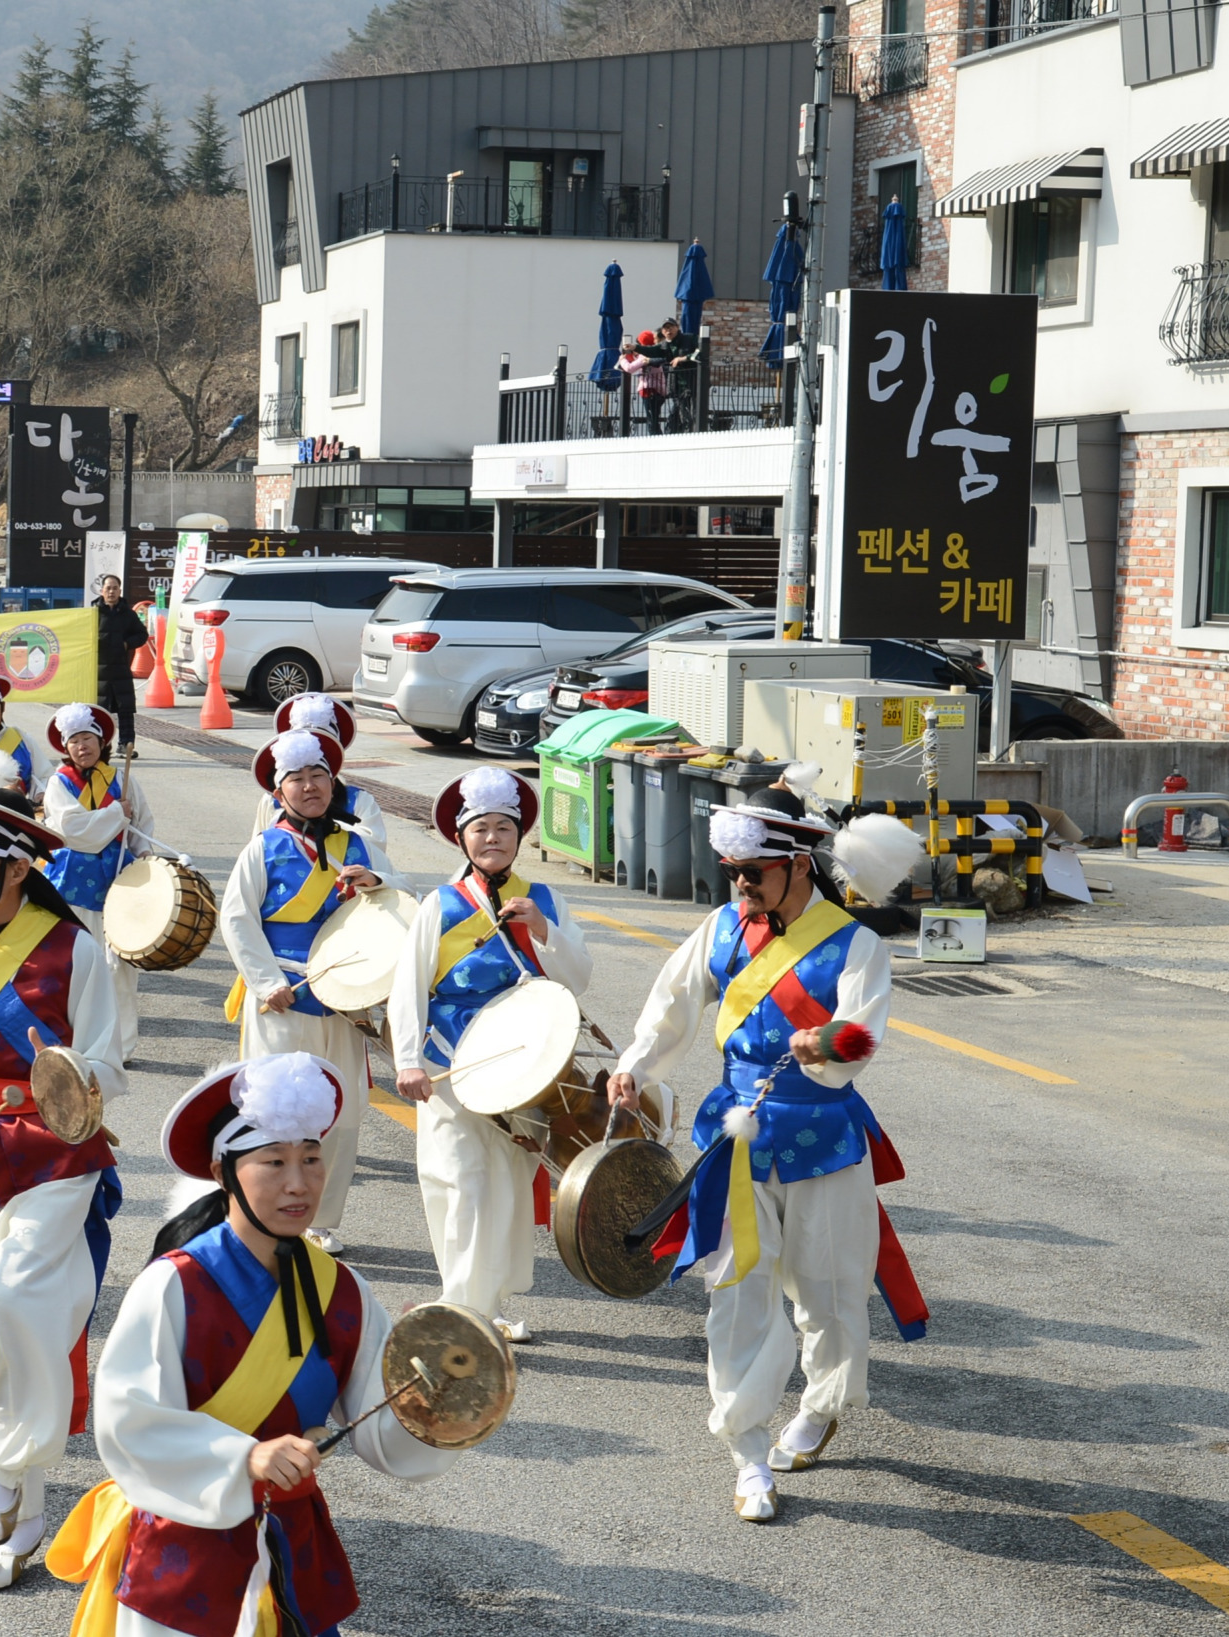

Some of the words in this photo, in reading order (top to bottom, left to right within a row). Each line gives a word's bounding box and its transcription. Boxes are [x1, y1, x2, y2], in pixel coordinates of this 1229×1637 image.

[868, 318, 1012, 504] 리움
[14, 522, 62, 531] 063-633-1800
[39, 538, 82, 558] 펜션
[857, 528, 930, 574] 펜션
[942, 532, 970, 570] &
[939, 577, 1013, 624] 카페
[887, 711, 901, 720] 501
